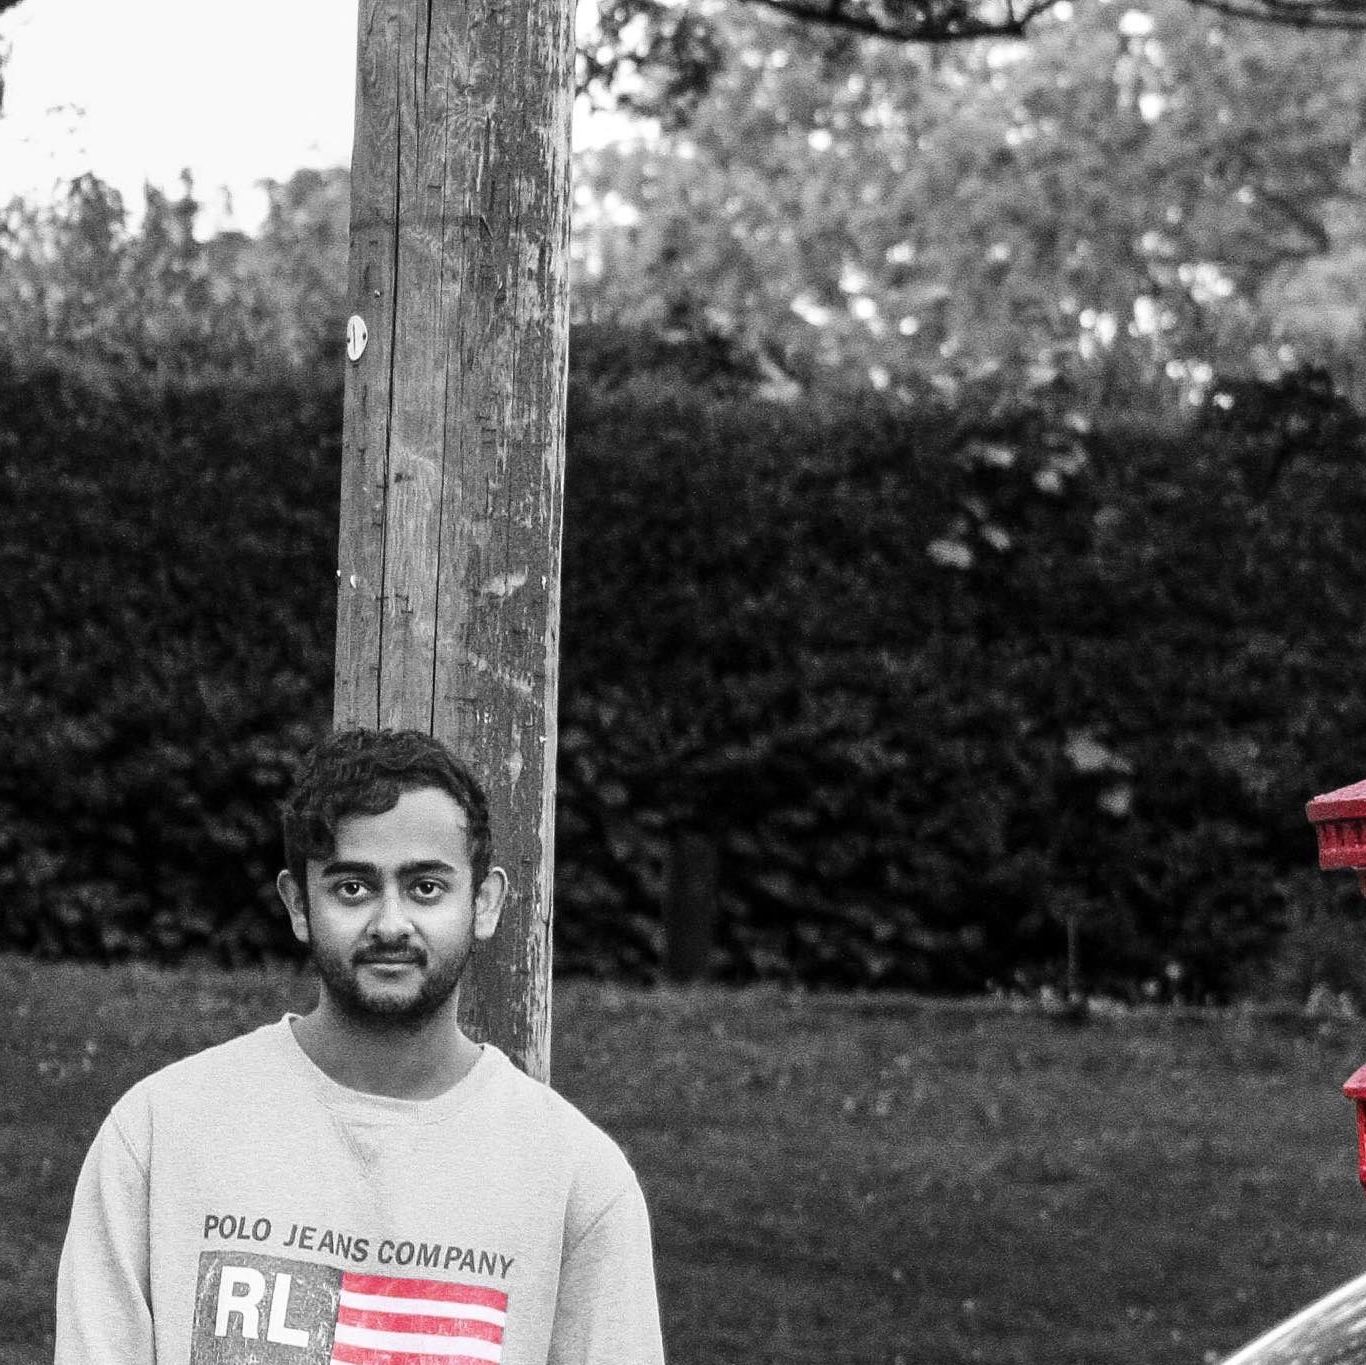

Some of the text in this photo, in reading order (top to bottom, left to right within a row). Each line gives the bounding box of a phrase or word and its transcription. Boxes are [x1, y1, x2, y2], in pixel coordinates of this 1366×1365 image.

[203, 1214, 515, 1279] POLO JEANS COMPANY
[214, 1265, 309, 1348] RL
